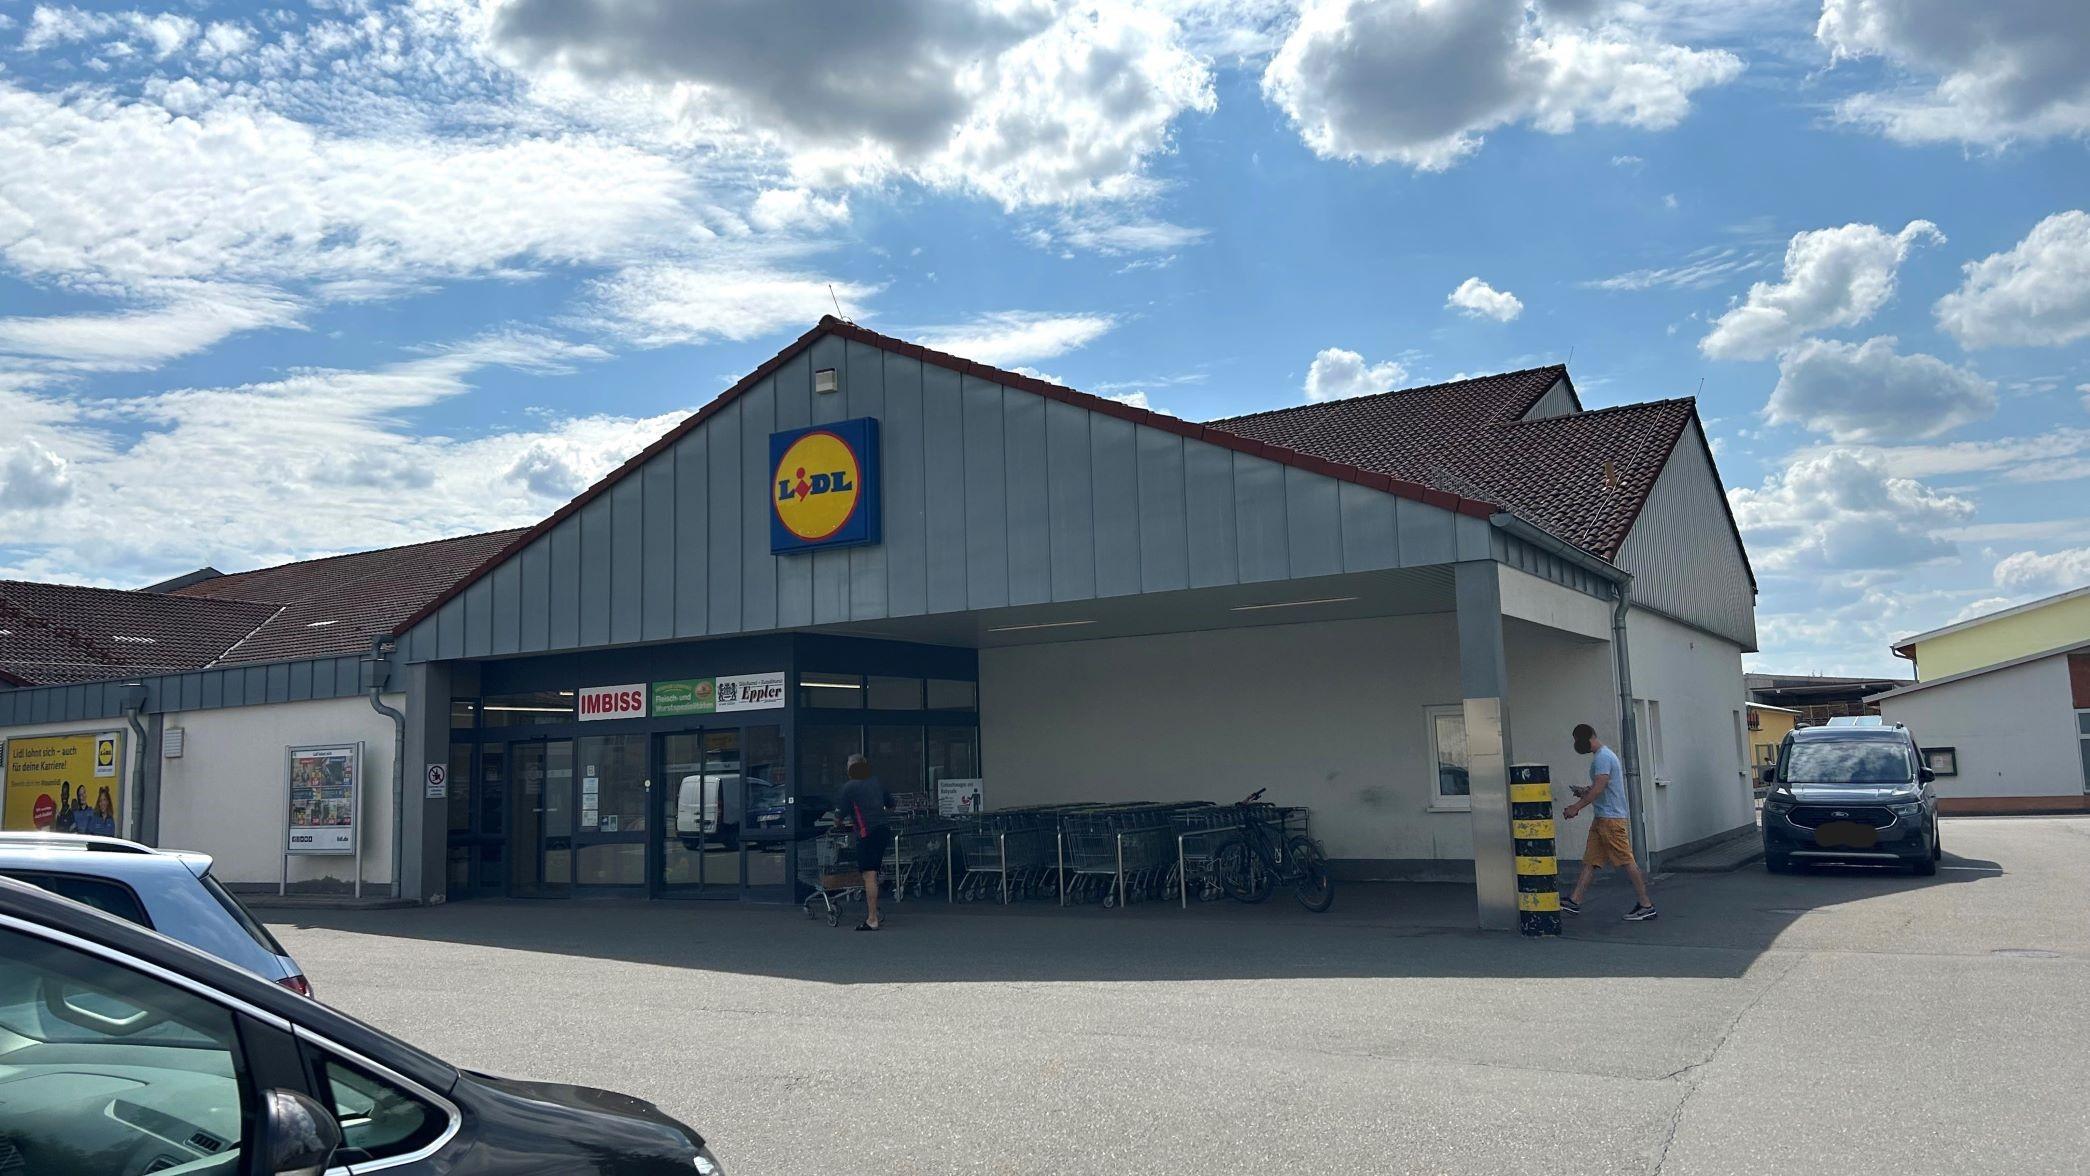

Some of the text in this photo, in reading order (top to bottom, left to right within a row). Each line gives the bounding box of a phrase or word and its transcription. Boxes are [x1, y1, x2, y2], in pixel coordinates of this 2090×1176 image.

[741, 685, 782, 703] Eppler
[581, 691, 642, 714] IMBISS
[42, 746, 56, 757] sich
[62, 746, 77, 756] auch
[12, 760, 67, 772] für deine Karriere!
